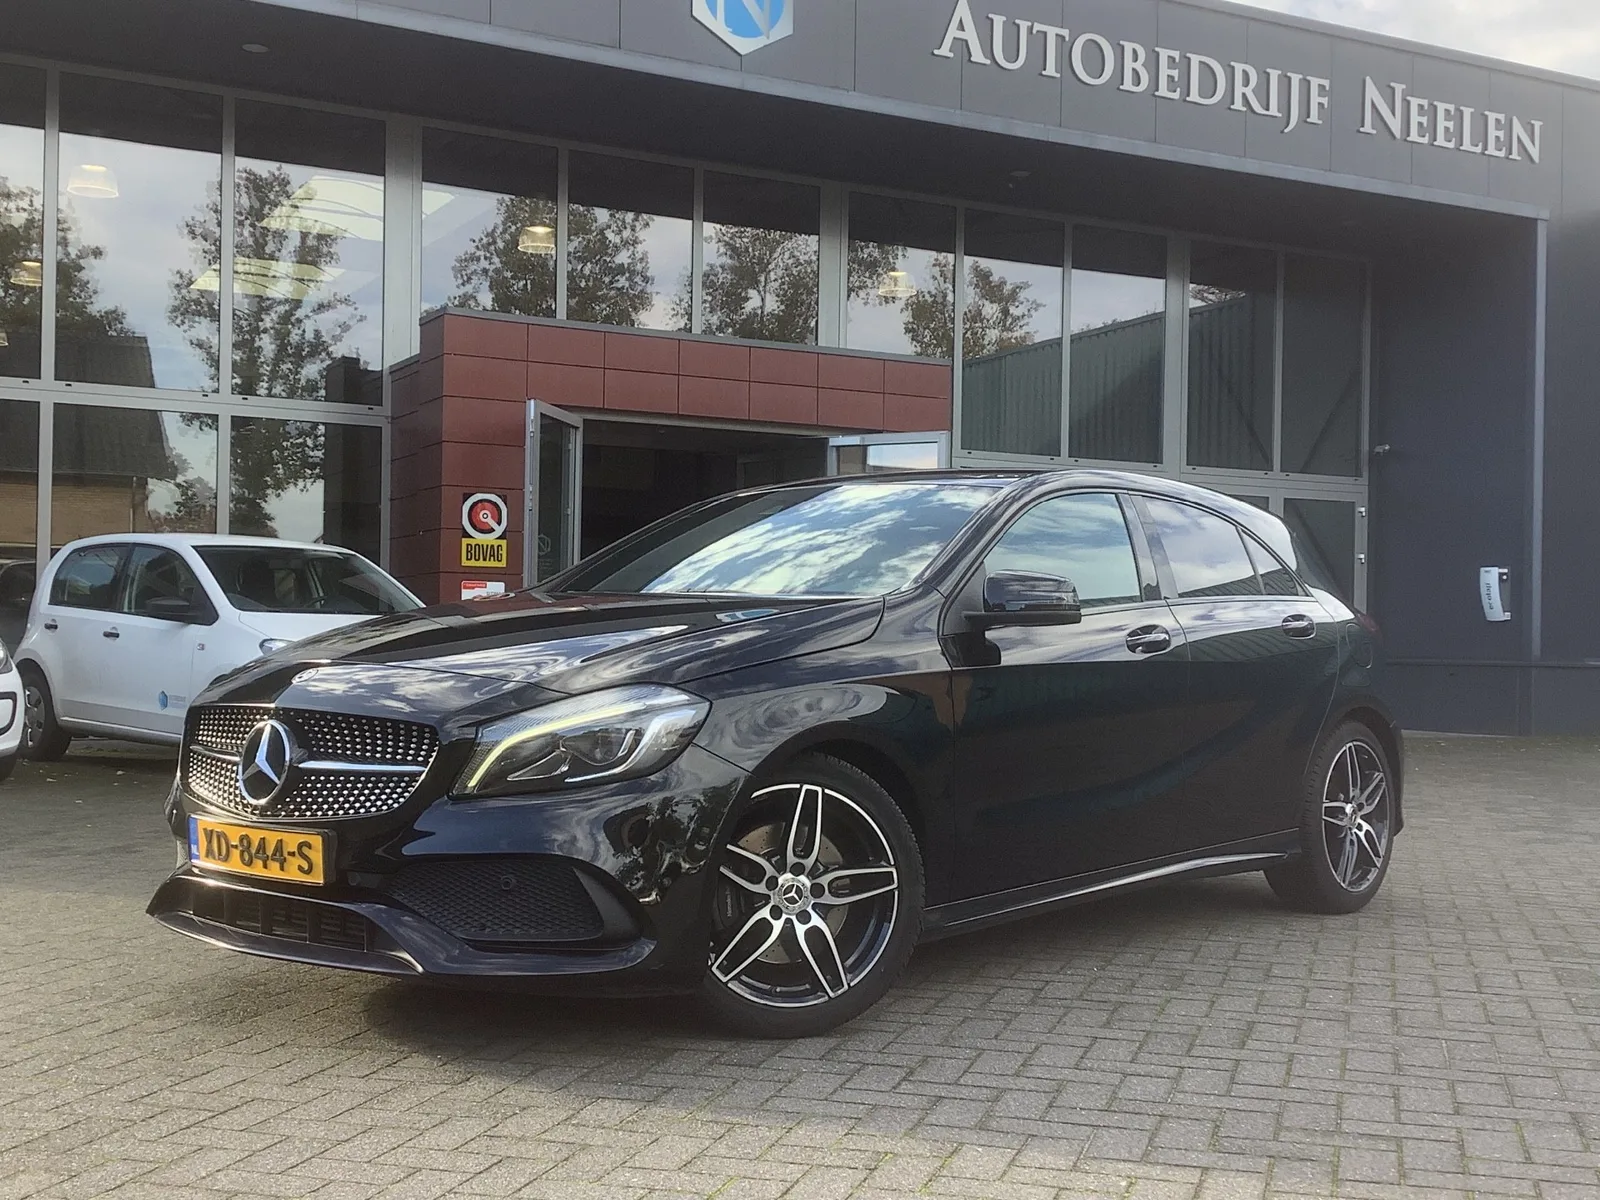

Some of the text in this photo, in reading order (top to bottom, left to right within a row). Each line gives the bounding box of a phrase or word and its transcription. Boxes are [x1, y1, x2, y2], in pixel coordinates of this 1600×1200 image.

[933, 0, 1543, 165] AUTOBEDRIJF NEELEN
[465, 543, 503, 562] BOVAG
[203, 827, 314, 875] XD-844-S
